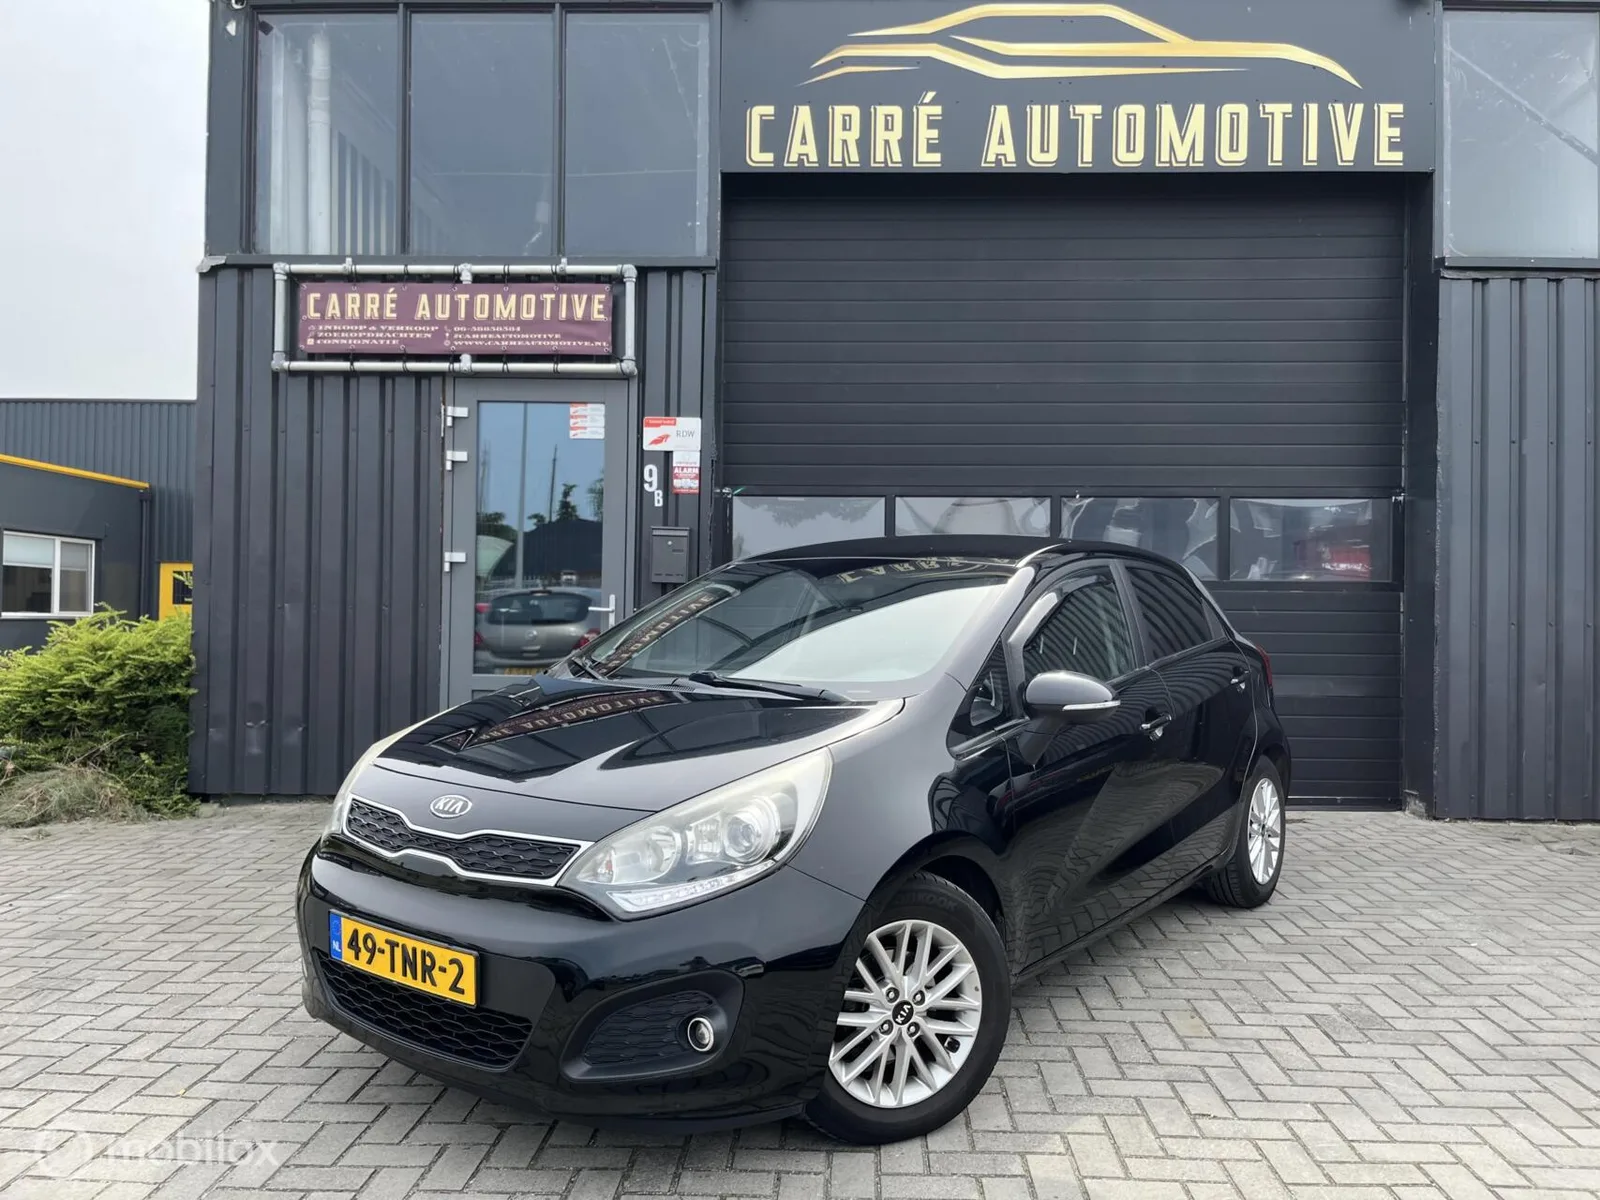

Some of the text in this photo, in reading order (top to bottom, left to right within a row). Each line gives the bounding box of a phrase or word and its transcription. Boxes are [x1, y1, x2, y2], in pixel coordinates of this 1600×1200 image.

[745, 91, 1404, 168] CARRÉ AUTOMOTIVE
[306, 288, 606, 321] CARRÉ AUTOMOTIVE
[317, 331, 432, 339] ZOEKOPDRACHTEN
[676, 430, 695, 438] RDW
[643, 464, 664, 507] 9 B
[434, 798, 463, 814] KIA
[332, 940, 342, 953] NL
[347, 928, 465, 994] 49-TNR-2
[895, 1004, 912, 1024] KIA
